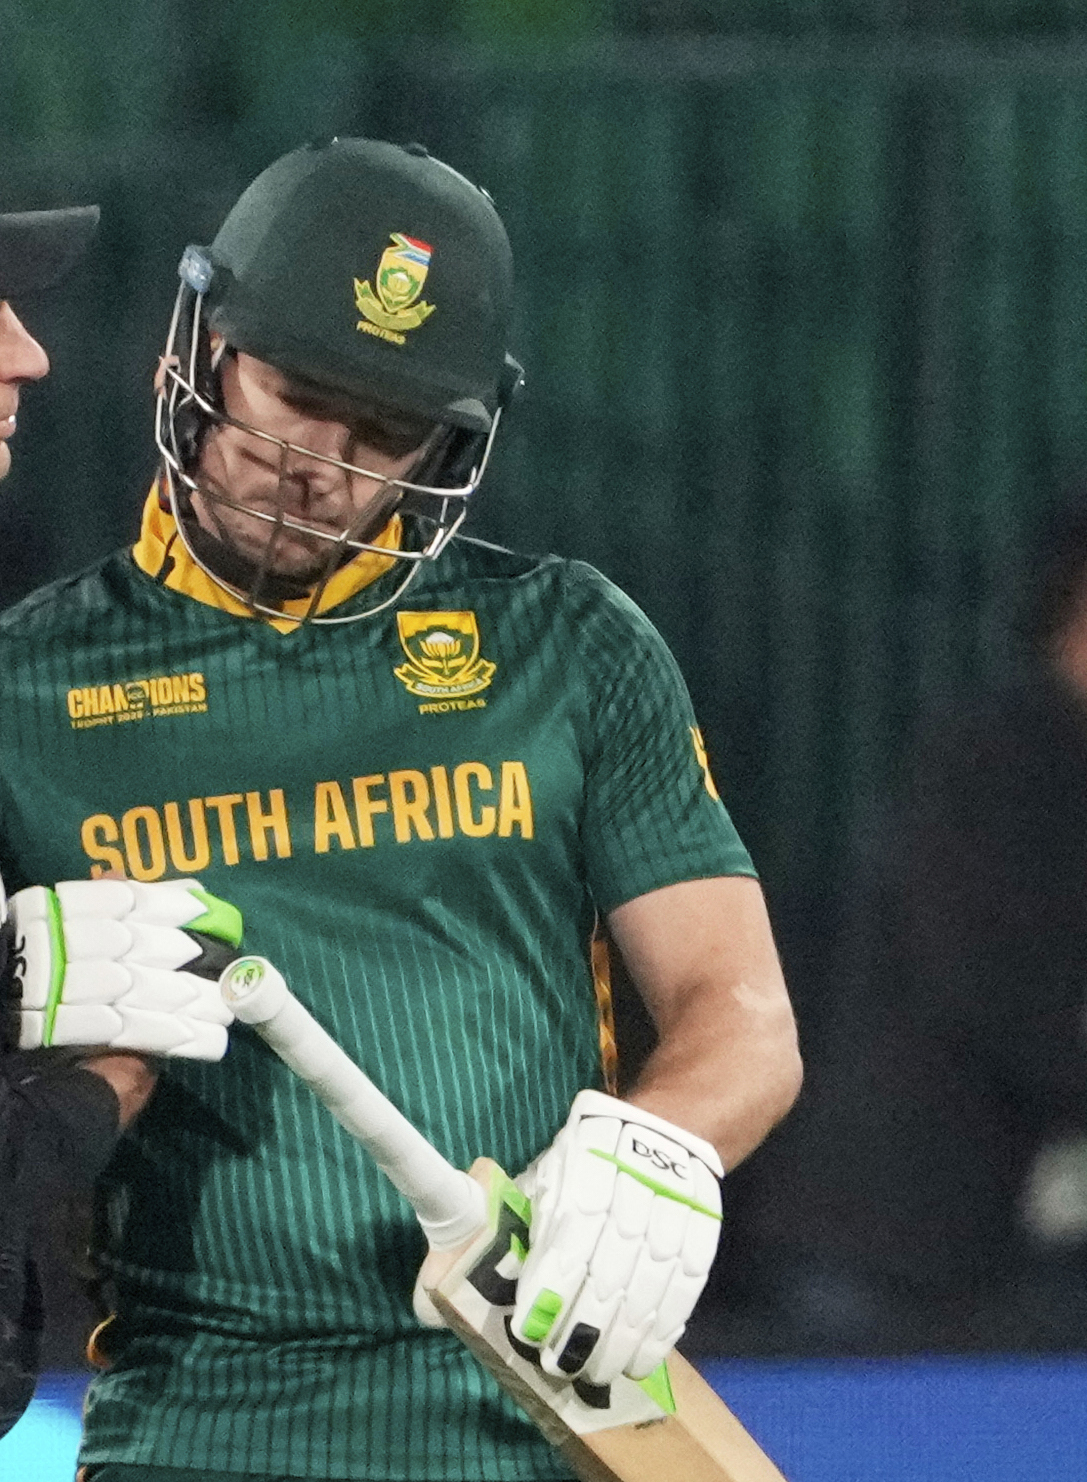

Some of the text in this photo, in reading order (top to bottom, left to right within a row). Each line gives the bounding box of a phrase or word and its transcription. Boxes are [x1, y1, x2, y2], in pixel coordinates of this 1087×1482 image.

[418, 699, 487, 715] PROTEAS
[80, 760, 536, 882] SOUTH AFRICA
[631, 1137, 688, 1181] DSC
